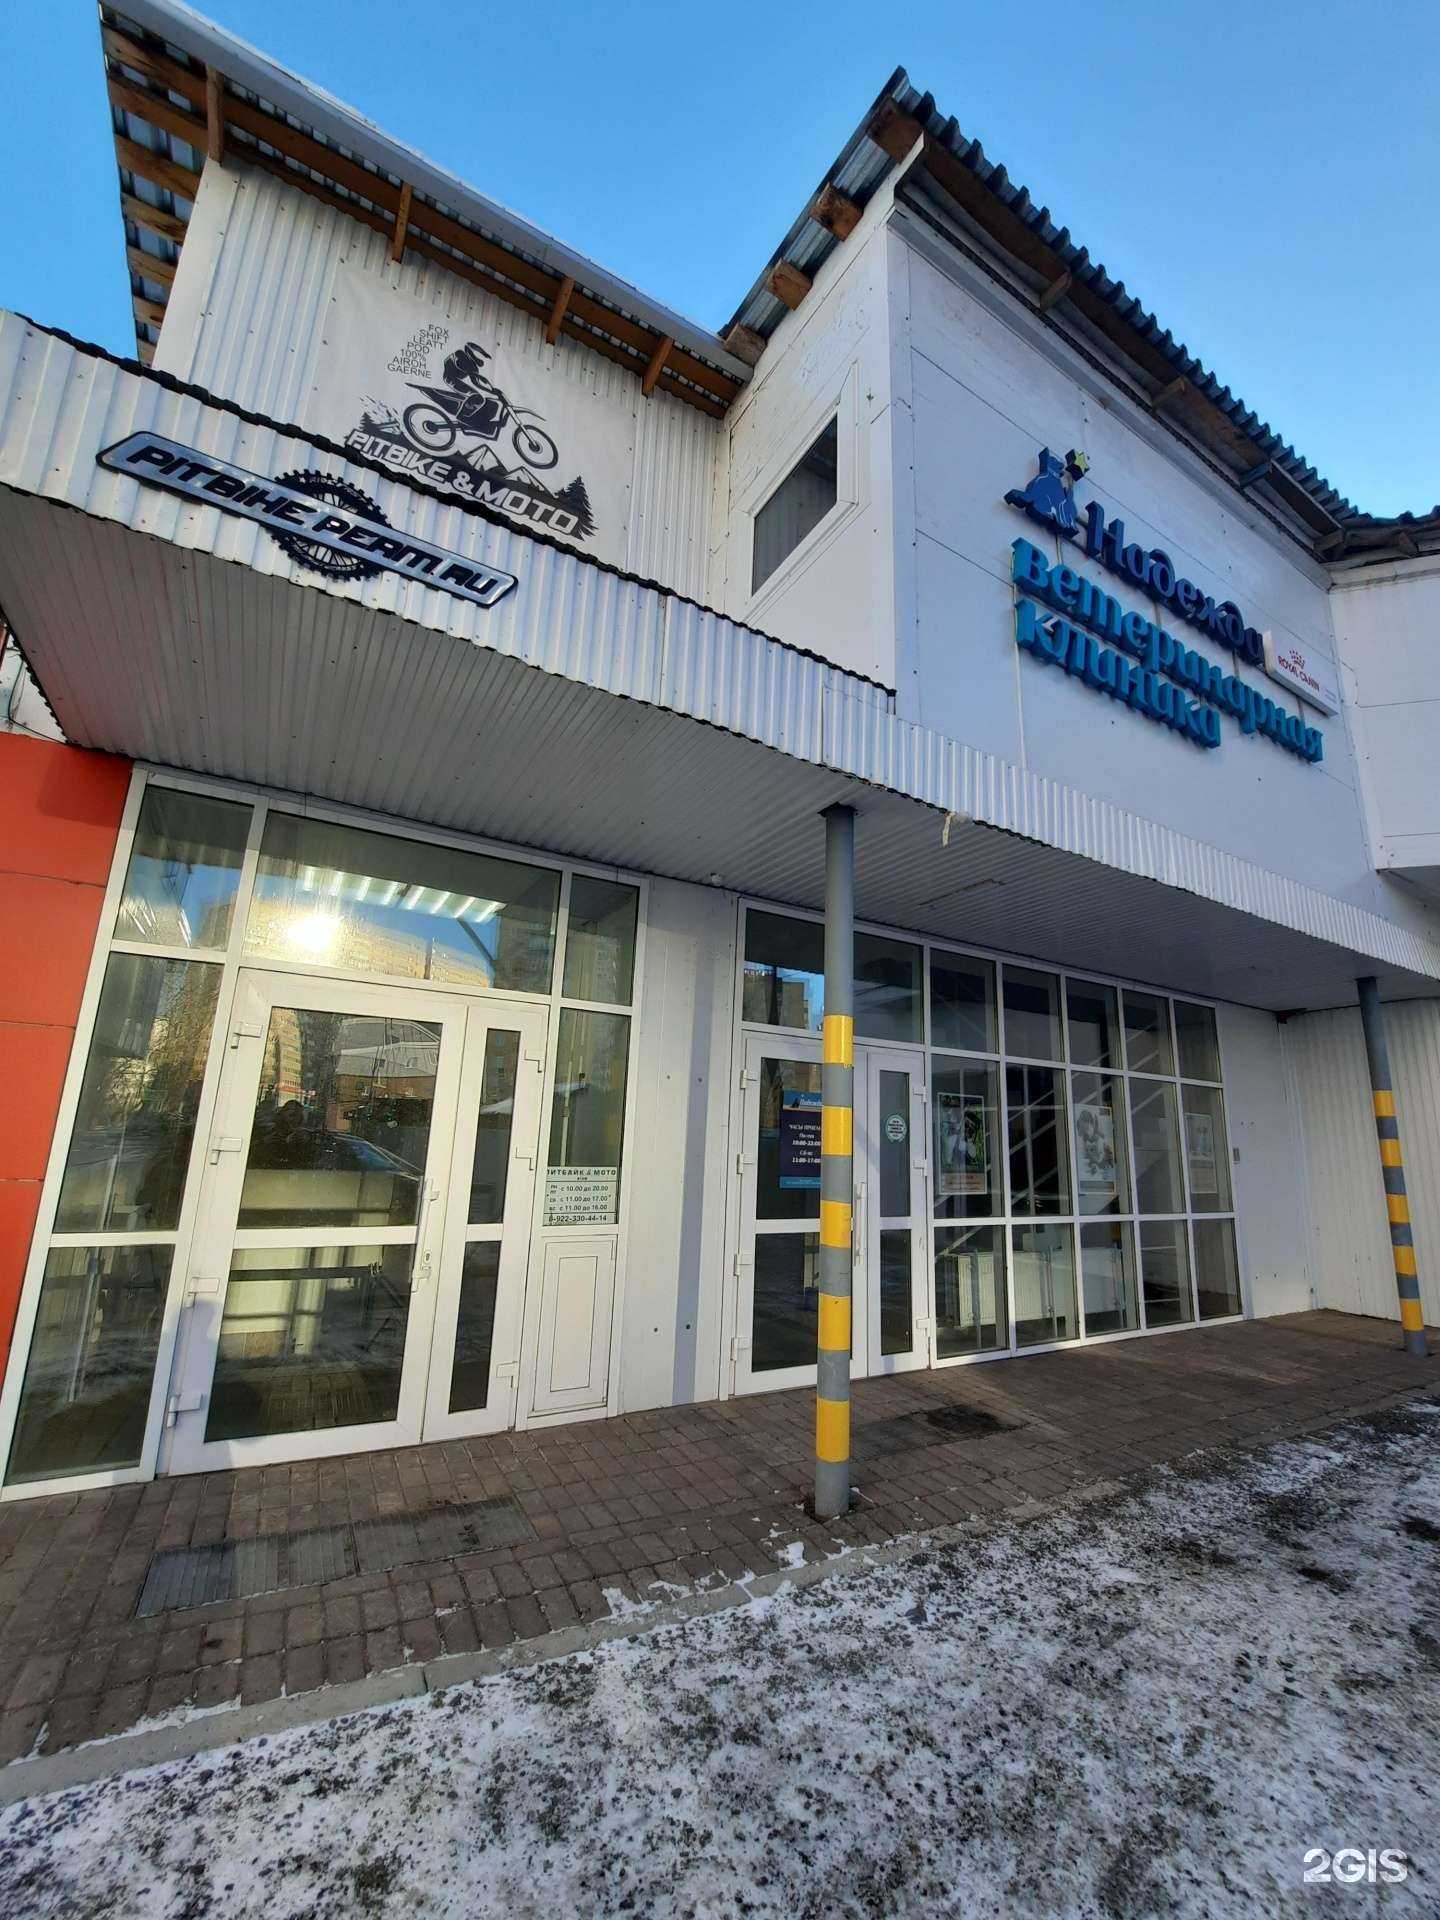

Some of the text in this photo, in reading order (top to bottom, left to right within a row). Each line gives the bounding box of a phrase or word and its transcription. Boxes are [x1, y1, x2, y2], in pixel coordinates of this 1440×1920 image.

[419, 329, 449, 344] SHIFT
[428, 324, 449, 337] FOX
[407, 341, 430, 354] POD
[413, 335, 445, 350] LEATT
[401, 348, 427, 362] 100%
[392, 356, 427, 370] AIROH
[387, 363, 432, 379] GAERNE
[346, 430, 579, 535] PITBIKE & MOTO
[126, 445, 499, 595] PITBIKE PERM.RU
[1084, 500, 1266, 667] Надежда
[1011, 536, 1324, 763] Ветеринарная
[1277, 655, 1320, 692] ROYAL CANIN
